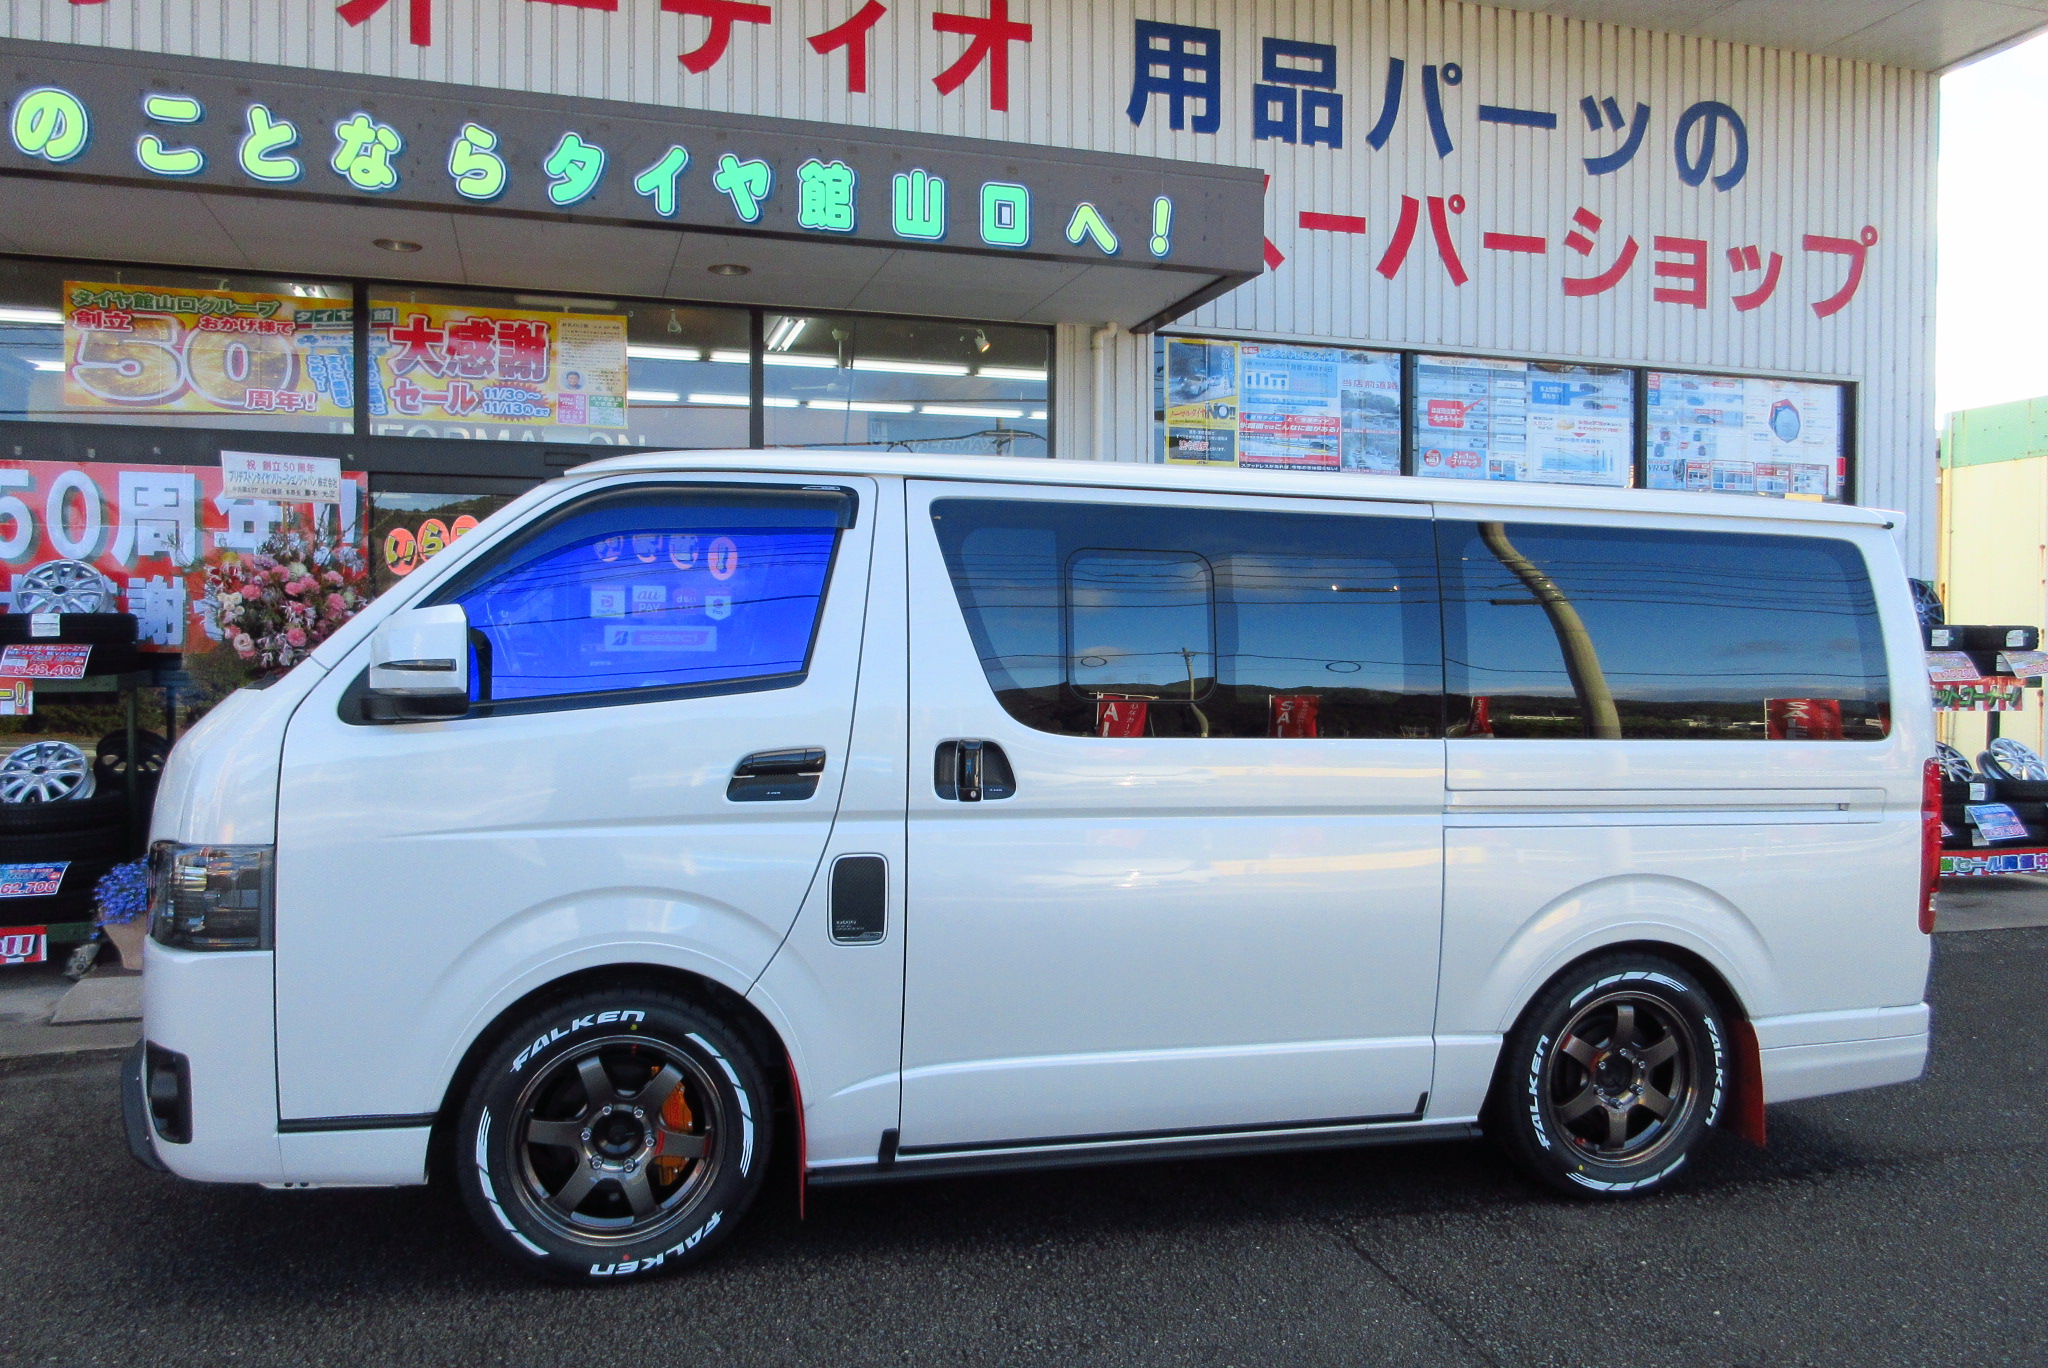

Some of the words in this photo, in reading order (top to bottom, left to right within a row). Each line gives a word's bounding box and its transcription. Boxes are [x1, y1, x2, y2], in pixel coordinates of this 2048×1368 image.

[1126, 19, 1749, 192] 用品パーツの
[1264, 172, 1878, 319] ーパーショップ
[74, 309, 133, 333] 創立
[199, 314, 296, 335] おかげ様で
[388, 314, 549, 383] 大感謝
[244, 388, 318, 412] 周年!
[389, 378, 479, 415] セール
[247, 460, 257, 470] 祝
[510, 1010, 646, 1073] FALKEN
[1703, 1014, 1723, 1126] FALKEN
[1529, 1034, 1550, 1150] FALKEN
[589, 1210, 723, 1276] FALKEN
